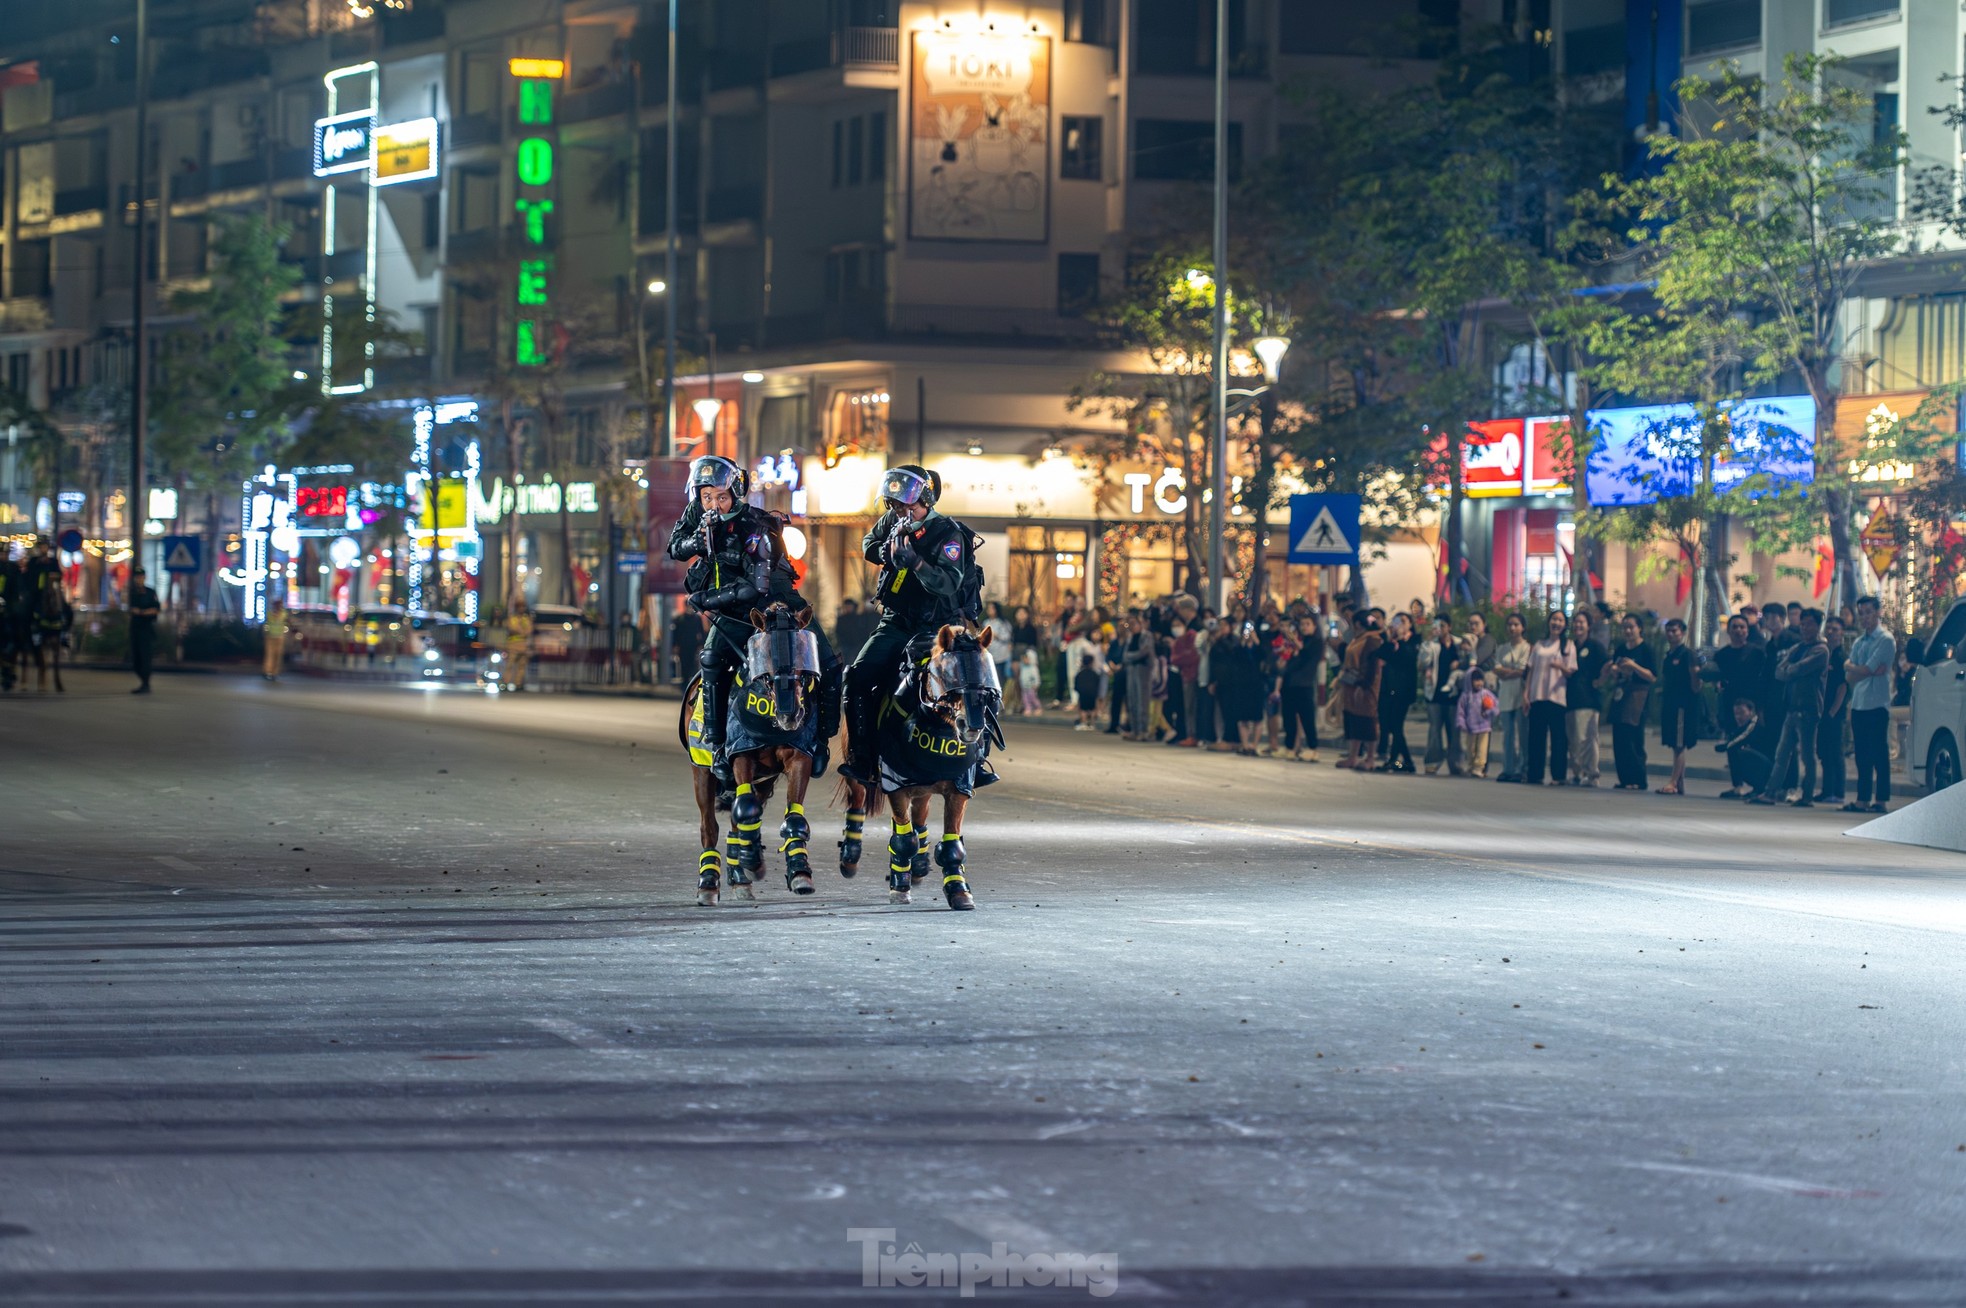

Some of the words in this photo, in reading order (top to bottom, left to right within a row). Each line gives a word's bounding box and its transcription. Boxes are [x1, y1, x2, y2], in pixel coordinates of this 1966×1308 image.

[516, 79, 554, 366] HOTEL
[746, 691, 781, 718] POL
[910, 725, 967, 757] POLICE
